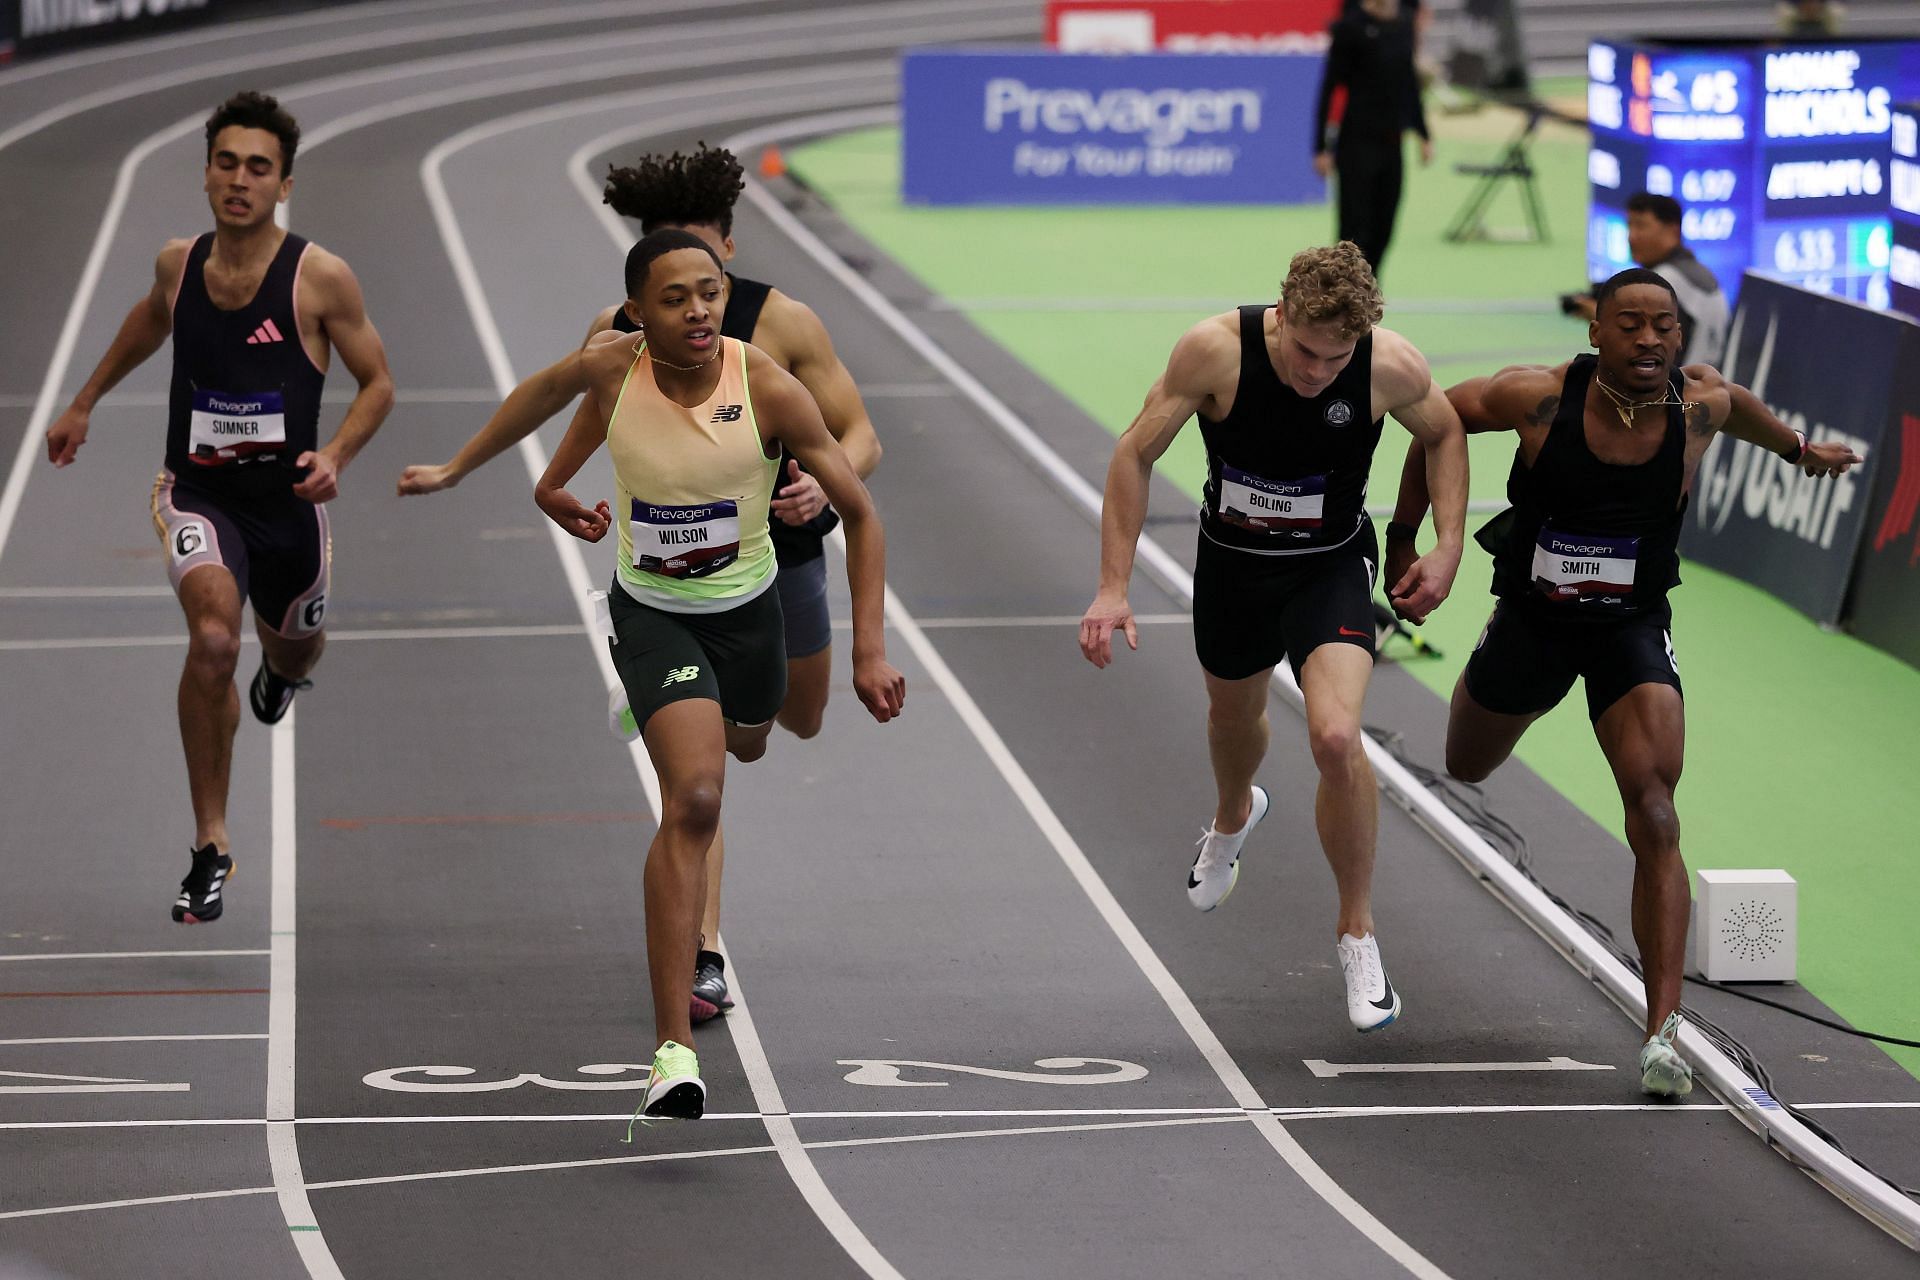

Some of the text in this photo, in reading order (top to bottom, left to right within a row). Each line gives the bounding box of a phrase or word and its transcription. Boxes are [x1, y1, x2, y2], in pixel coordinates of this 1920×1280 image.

[984, 78, 1262, 147] Prevagen
[209, 397, 263, 415] Prevagen
[212, 419, 259, 436] SUMNER
[1242, 475, 1303, 494] Prevagen
[1249, 492, 1292, 513] BOLING
[649, 507, 713, 522] Prevagen
[176, 525, 202, 557] 6
[658, 526, 708, 545] WILSON
[1551, 539, 1613, 556] Prevagen
[1561, 560, 1601, 575] SMITH
[304, 594, 325, 628] 6
[836, 1056, 1149, 1087] 2
[1302, 1056, 1617, 1078] 1
